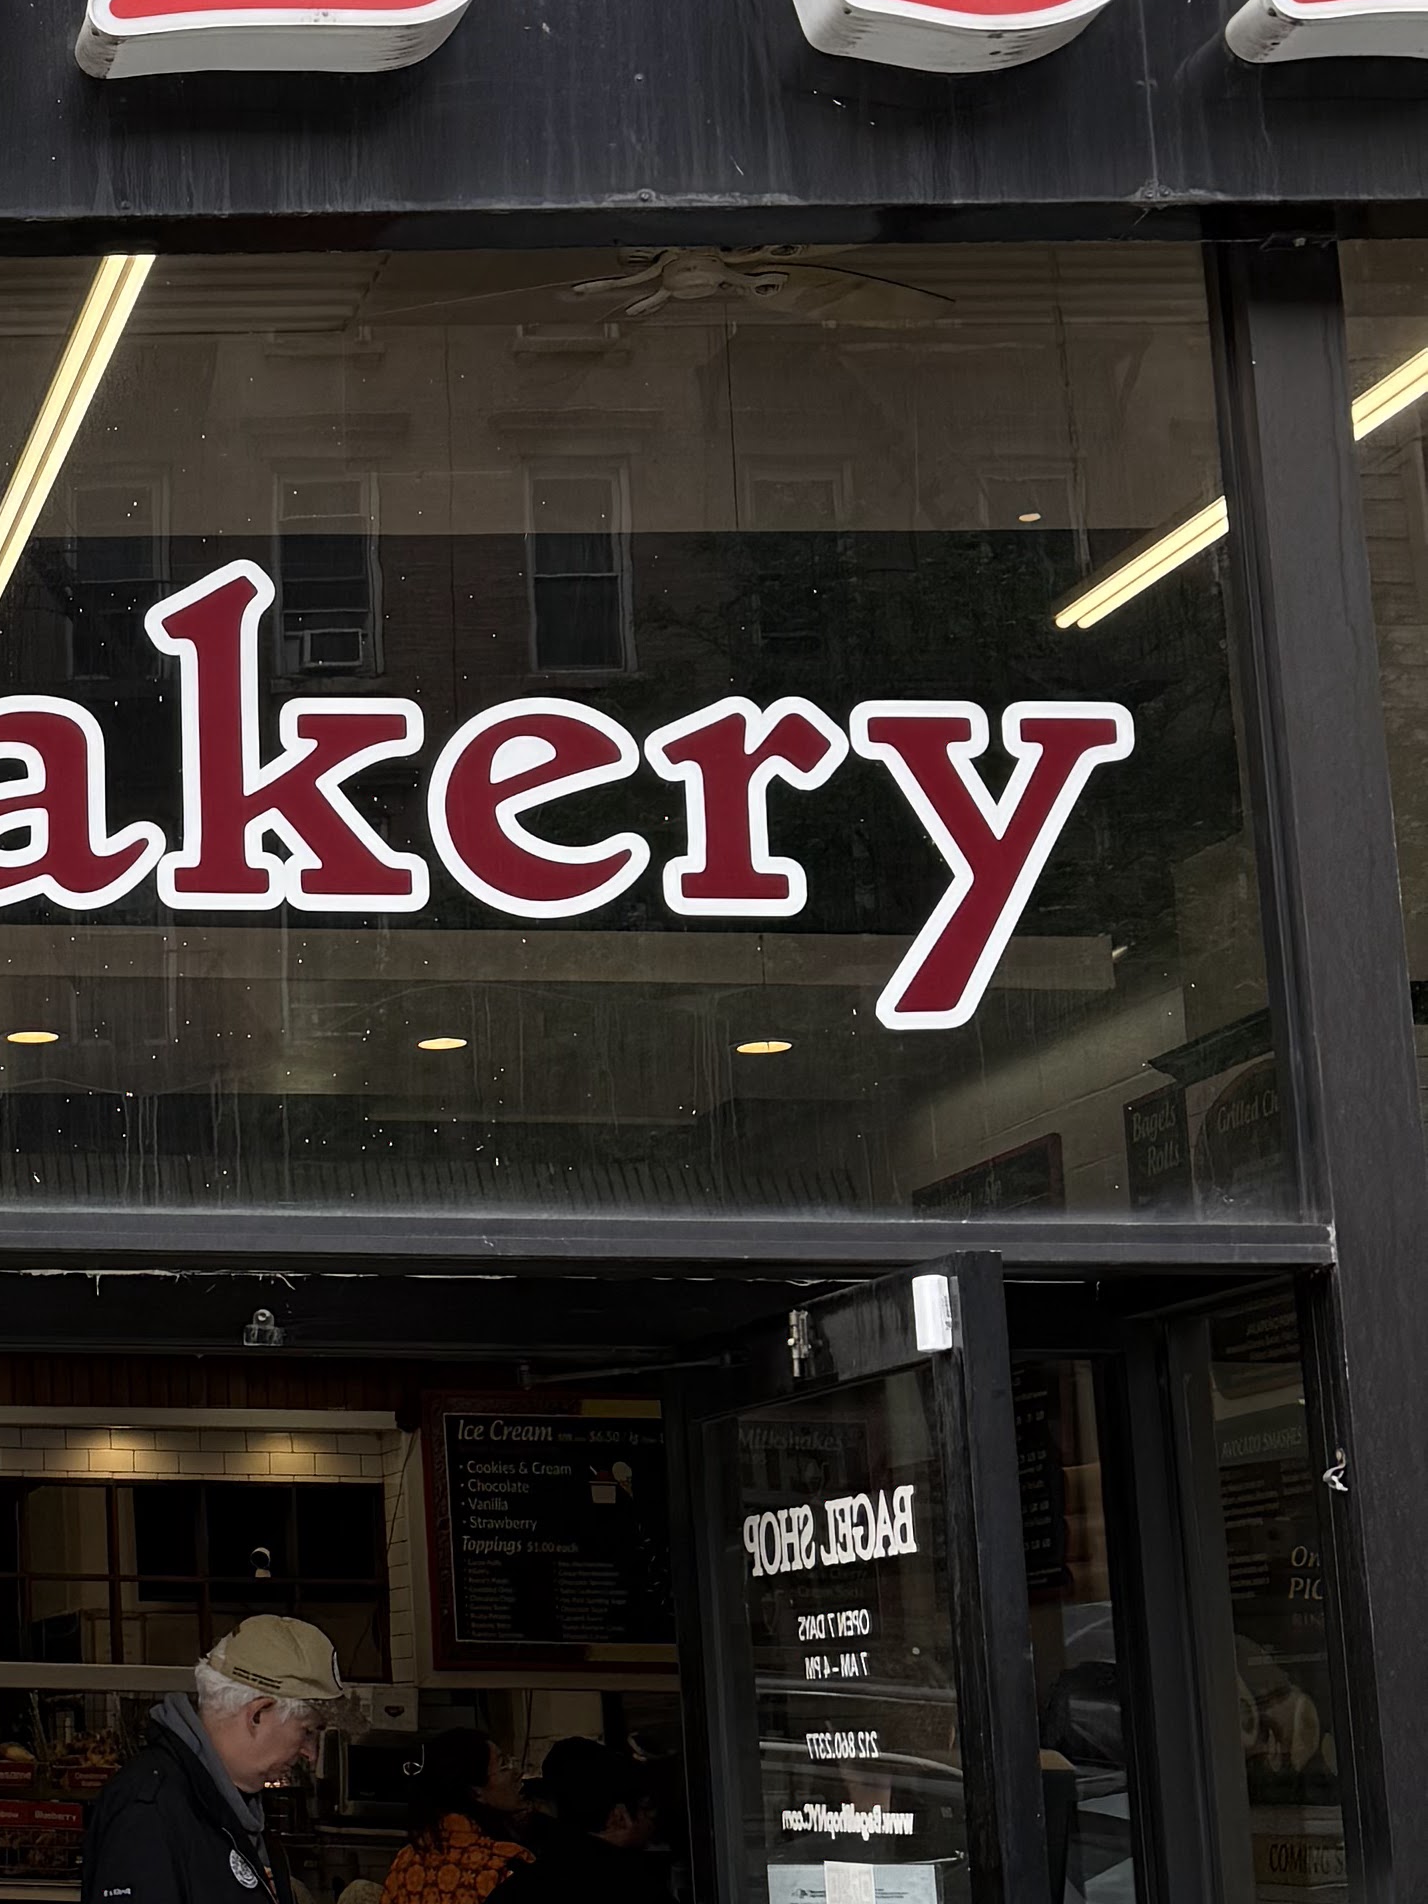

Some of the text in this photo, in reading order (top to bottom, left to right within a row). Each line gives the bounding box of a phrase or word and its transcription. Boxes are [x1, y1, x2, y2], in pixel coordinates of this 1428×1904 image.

[1131, 1100, 1177, 1143] Bagels
[1146, 1140, 1180, 1178] Rolls
[457, 1419, 485, 1441] Ice
[489, 1419, 553, 1442] Cream
[466, 1460, 573, 1476] Cookies & Cream
[467, 1479, 531, 1494] Chocolate
[467, 1497, 509, 1512] Vanilla
[469, 1515, 538, 1532] Strawberry
[461, 1535, 523, 1555] Toppings
[526, 1542, 555, 1554] $1.00
